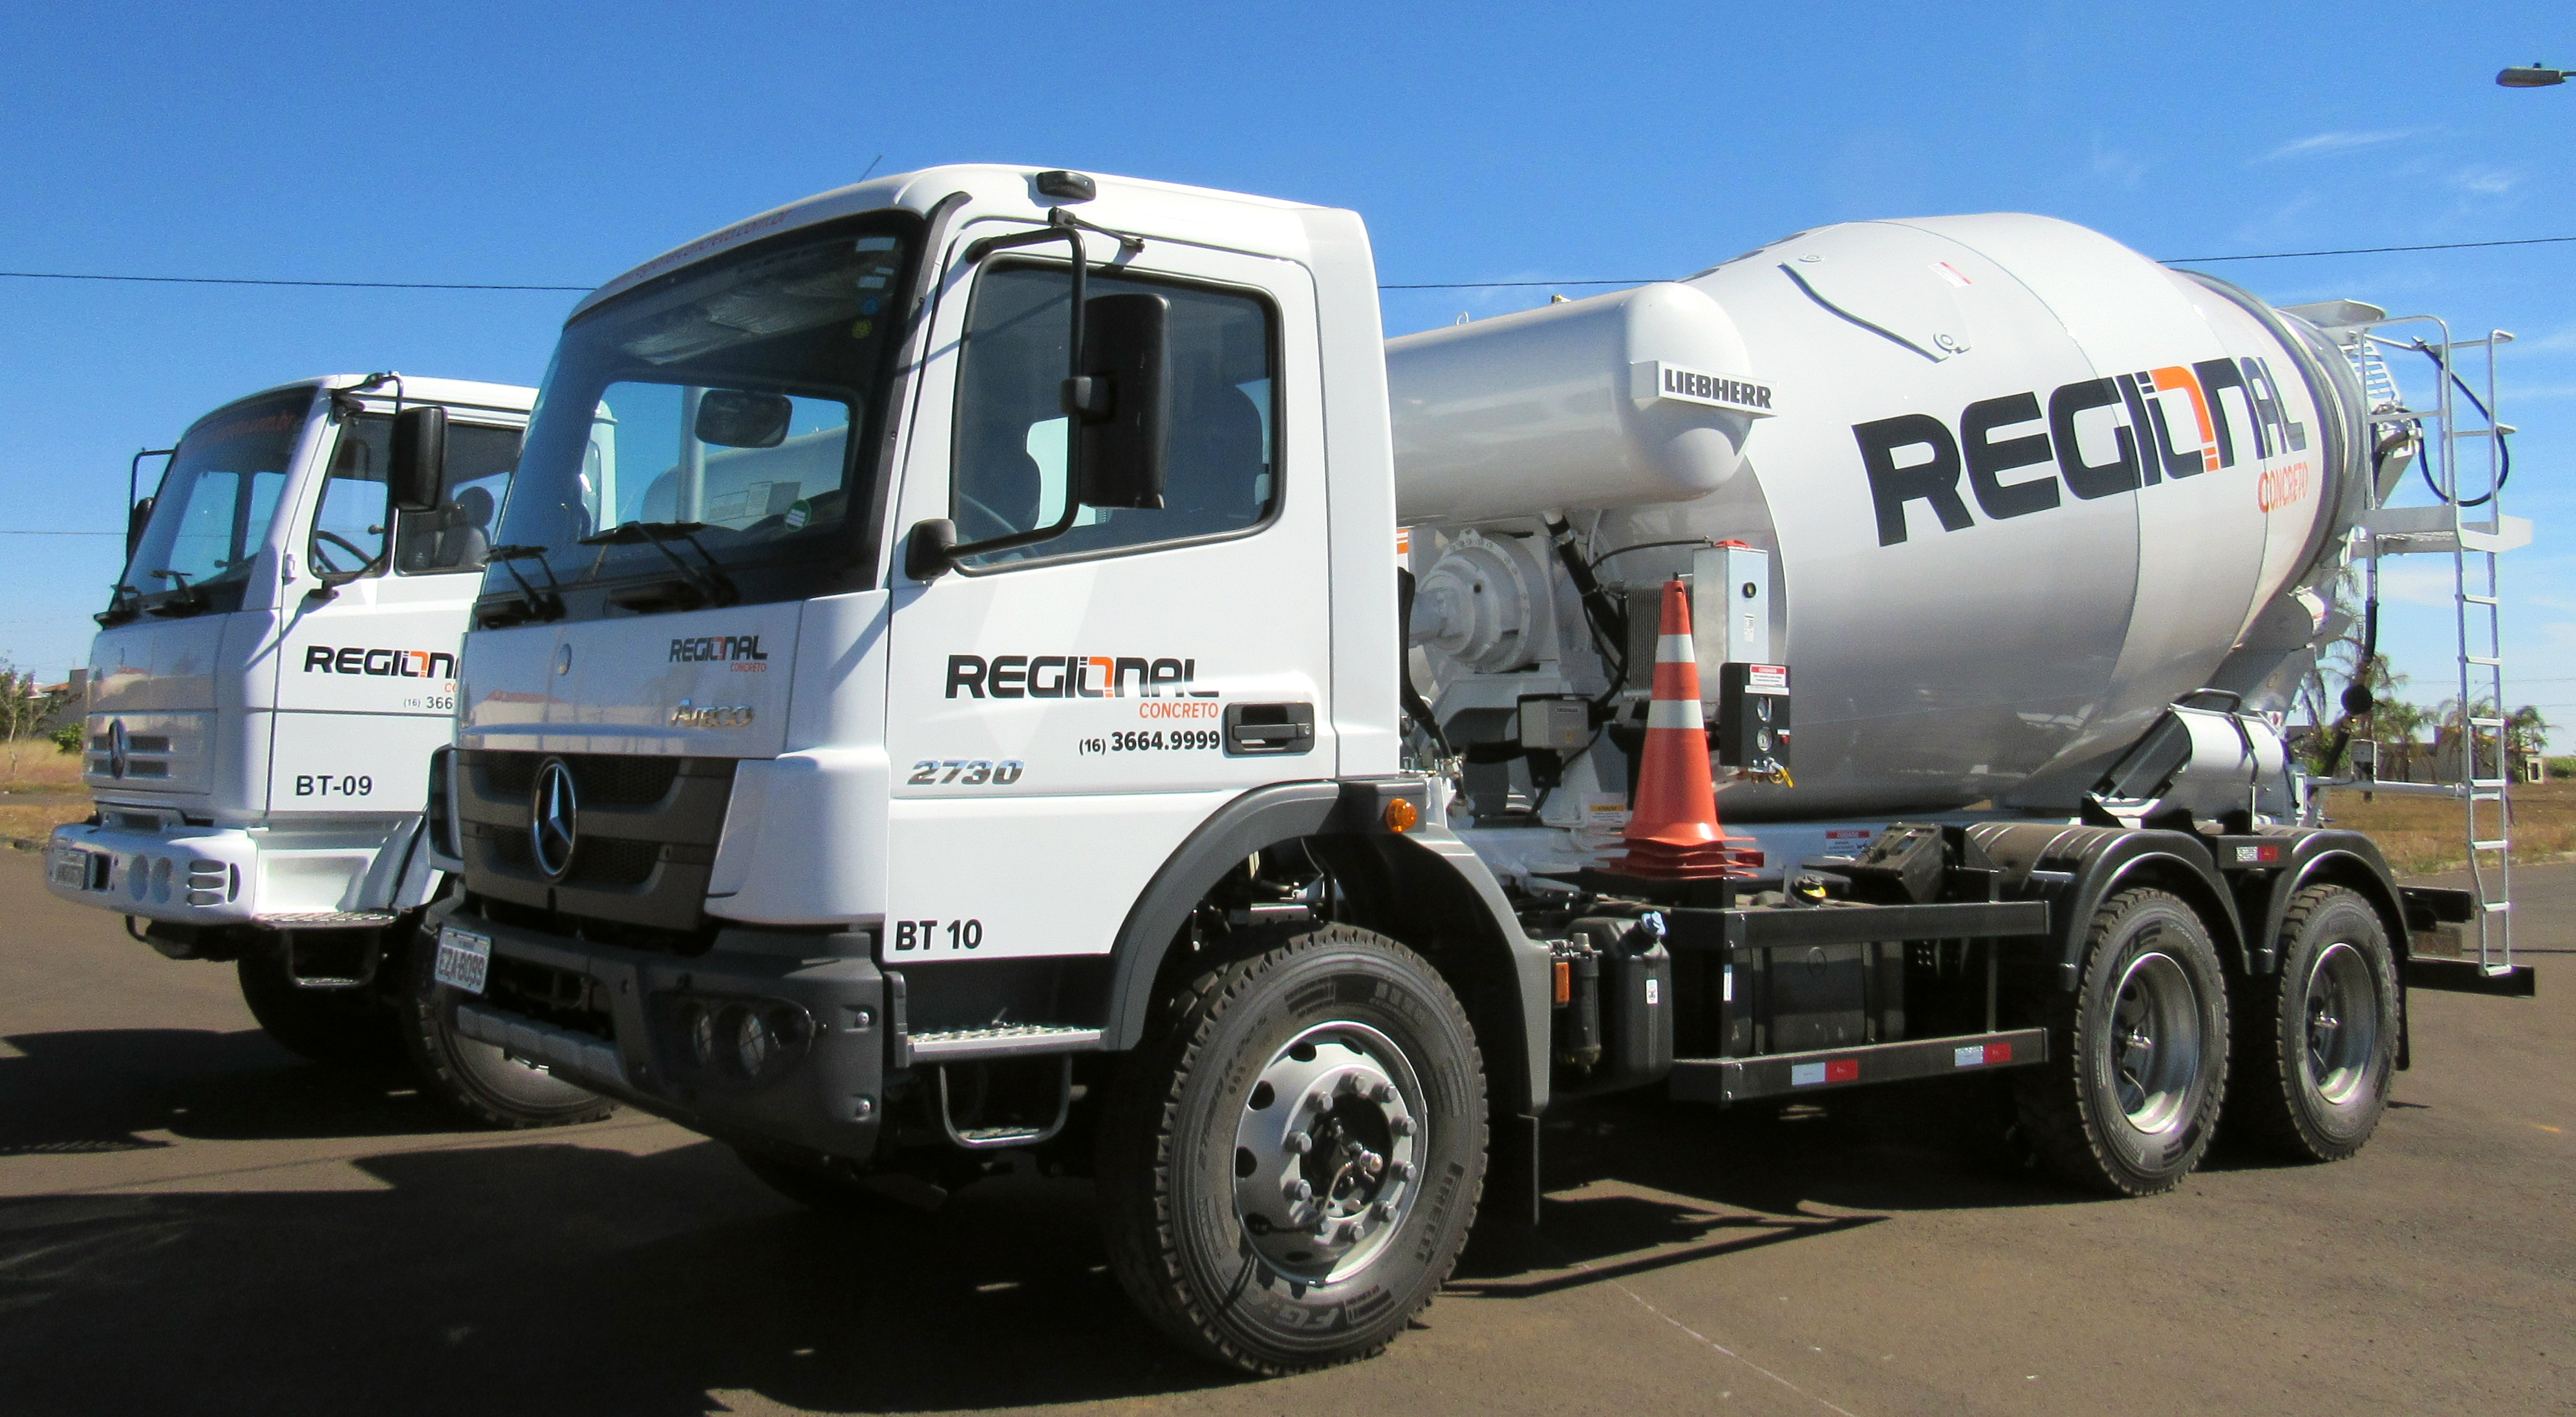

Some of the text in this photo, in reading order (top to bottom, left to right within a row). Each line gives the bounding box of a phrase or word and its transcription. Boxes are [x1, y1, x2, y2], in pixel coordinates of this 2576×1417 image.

[1664, 368, 1772, 409] LIEBHERR
[1851, 356, 2307, 547] REGIONAL
[2258, 462, 2308, 513] CONCRETO
[669, 635, 768, 663] REGIONAL
[731, 662, 767, 672] CONCRETO
[945, 655, 1220, 699] REGIONAL
[403, 698, 420, 707] (16)
[1139, 703, 1219, 719] CONCRETO
[1079, 730, 1221, 756] (16) 3664.9999
[295, 775, 373, 796] BT-09
[907, 760, 1025, 785] 2730
[896, 919, 982, 950] BT 10
